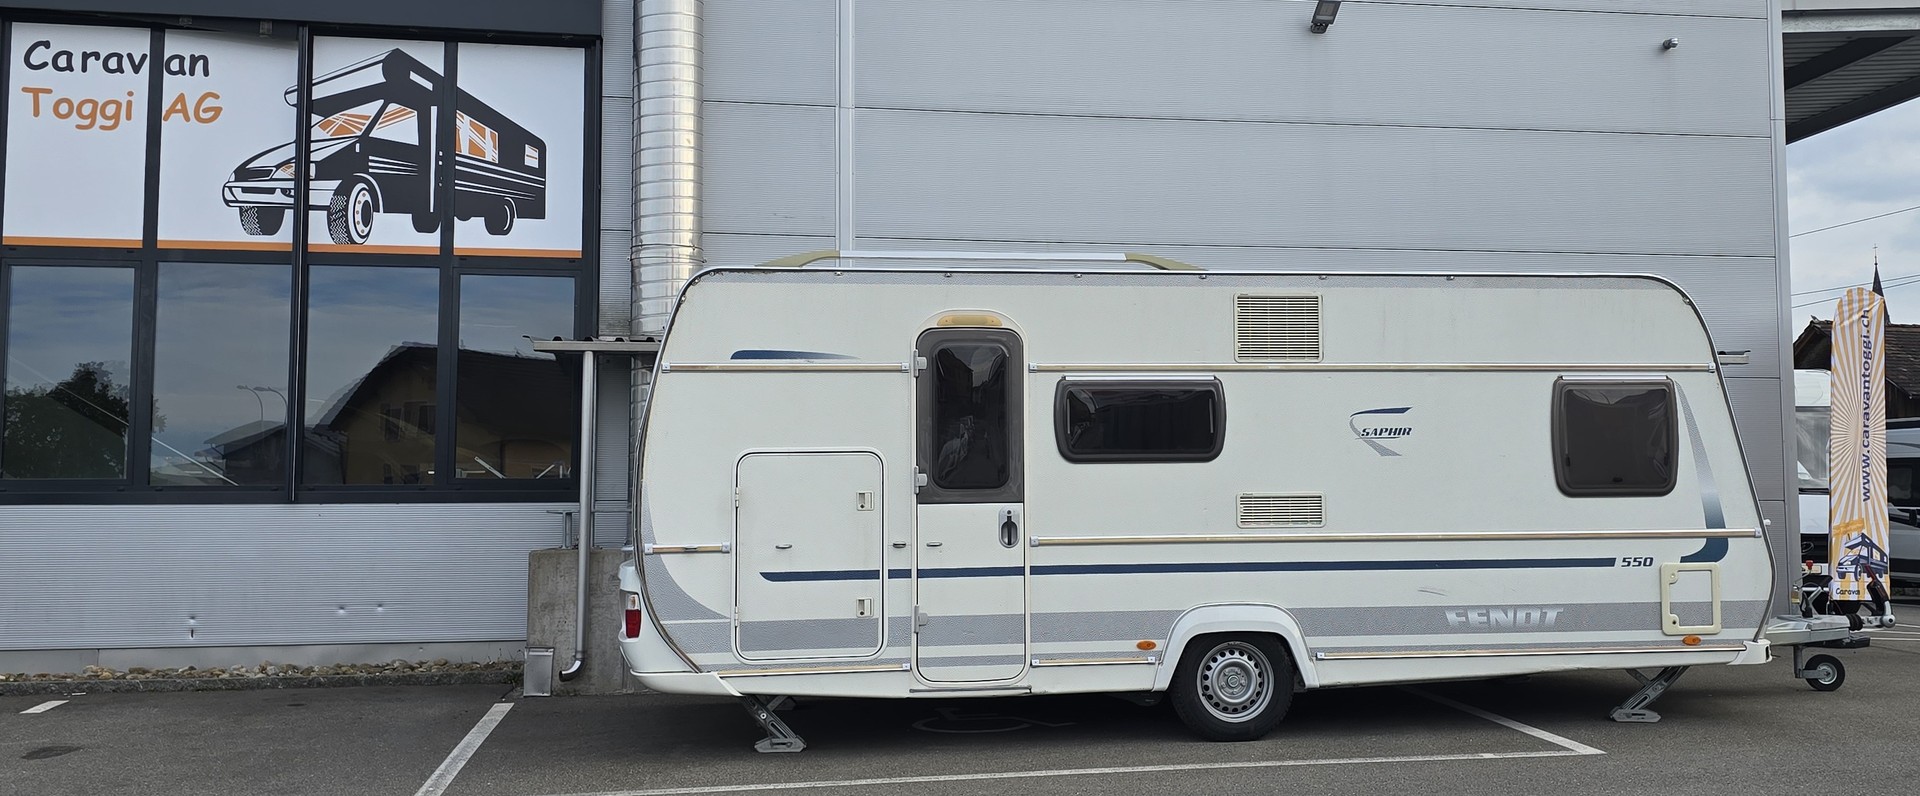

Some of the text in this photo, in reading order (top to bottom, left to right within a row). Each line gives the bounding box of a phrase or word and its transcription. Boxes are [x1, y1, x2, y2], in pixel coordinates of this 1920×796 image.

[23, 40, 210, 77] Caravan
[21, 86, 223, 131] Toggi AG
[1861, 308, 1873, 502] www.caravantoggi.ch
[1360, 427, 1413, 437] SAPHIR
[1621, 556, 1654, 568] 550
[1445, 607, 1564, 627] FENDT
